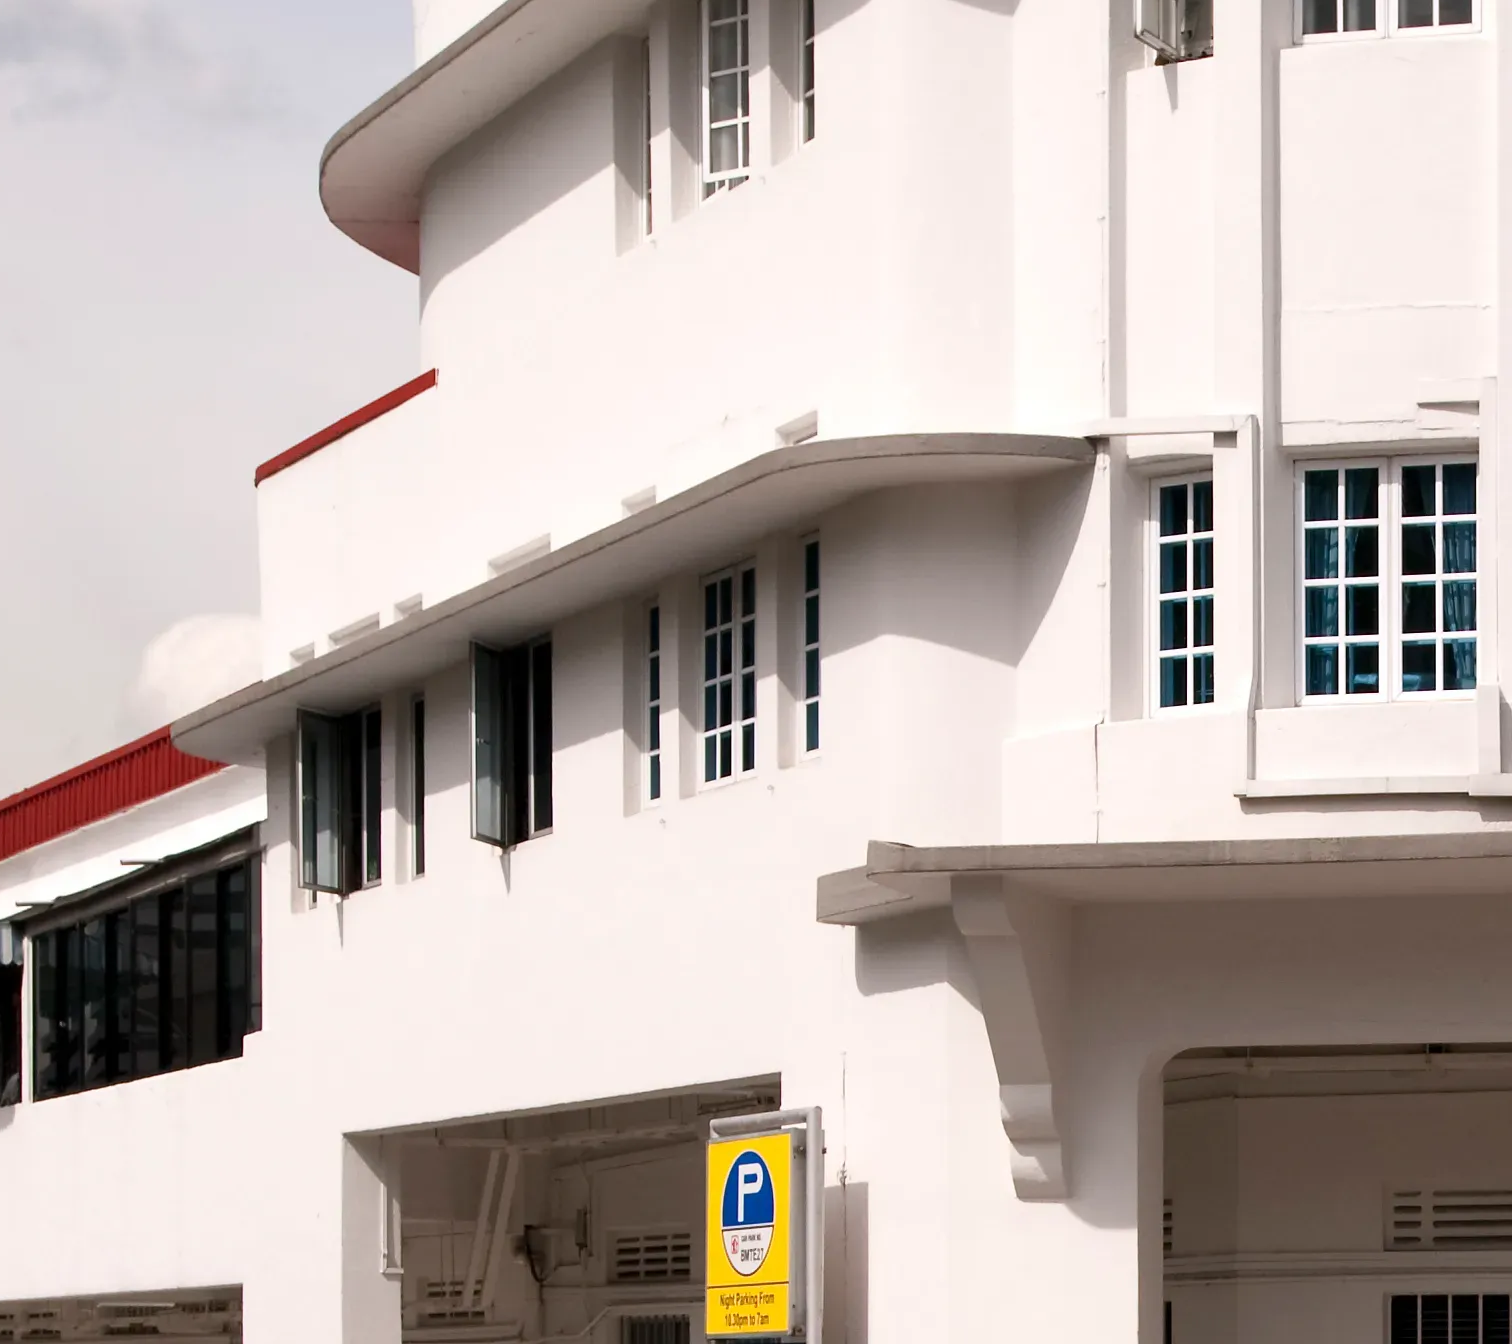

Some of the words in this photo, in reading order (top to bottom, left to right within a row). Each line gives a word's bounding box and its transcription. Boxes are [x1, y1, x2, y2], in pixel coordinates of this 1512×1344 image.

[737, 1162, 764, 1223] P
[741, 1248, 764, 1262] BMTE27
[720, 1293, 735, 1310] Night
[737, 1292, 758, 1308] Parking
[760, 1292, 775, 1304] From
[749, 1314, 755, 1326] to
[757, 1313, 770, 1326] 7am
